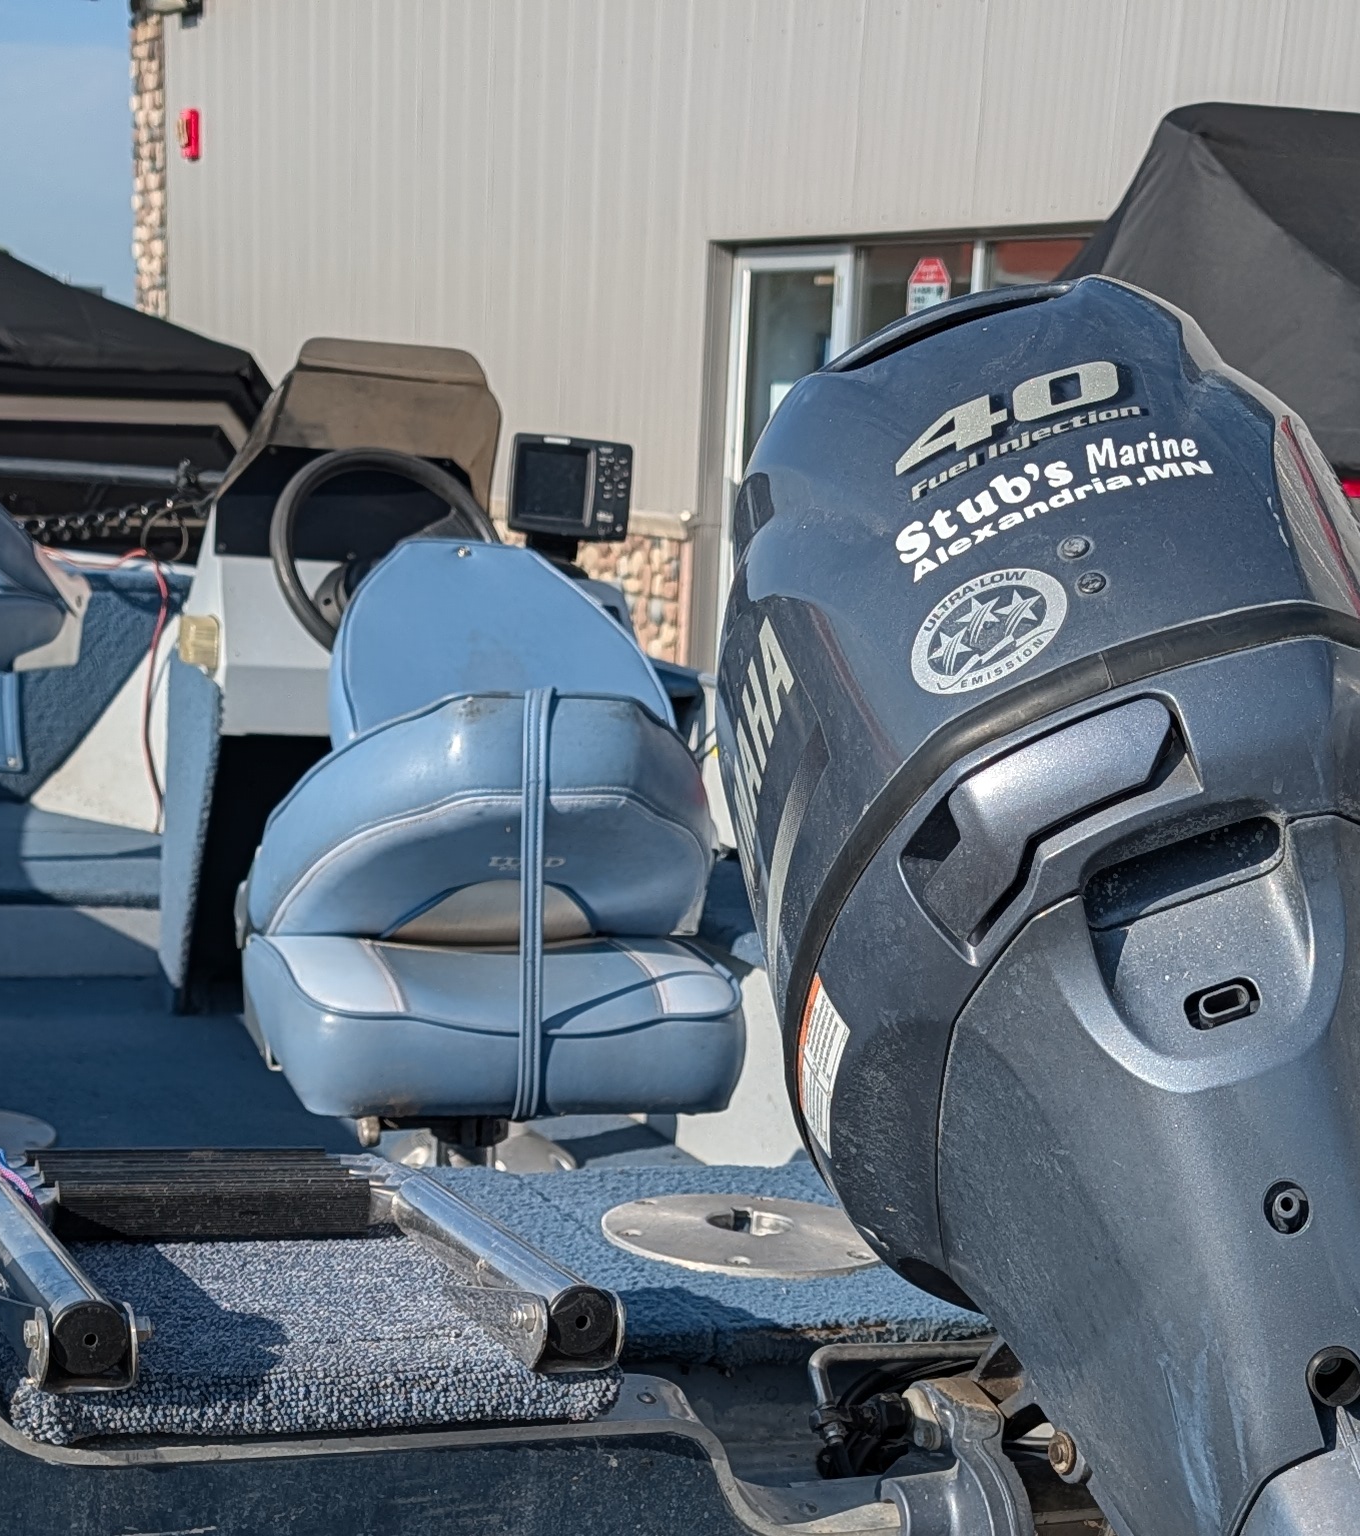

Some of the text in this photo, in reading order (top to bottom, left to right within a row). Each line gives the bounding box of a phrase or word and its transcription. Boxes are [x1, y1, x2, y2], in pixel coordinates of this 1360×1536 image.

[896, 361, 1119, 476] 40
[912, 406, 1140, 500] Fuel Injection
[895, 432, 1198, 564] Stub's Marine
[960, 638, 1044, 688] EMISSION
